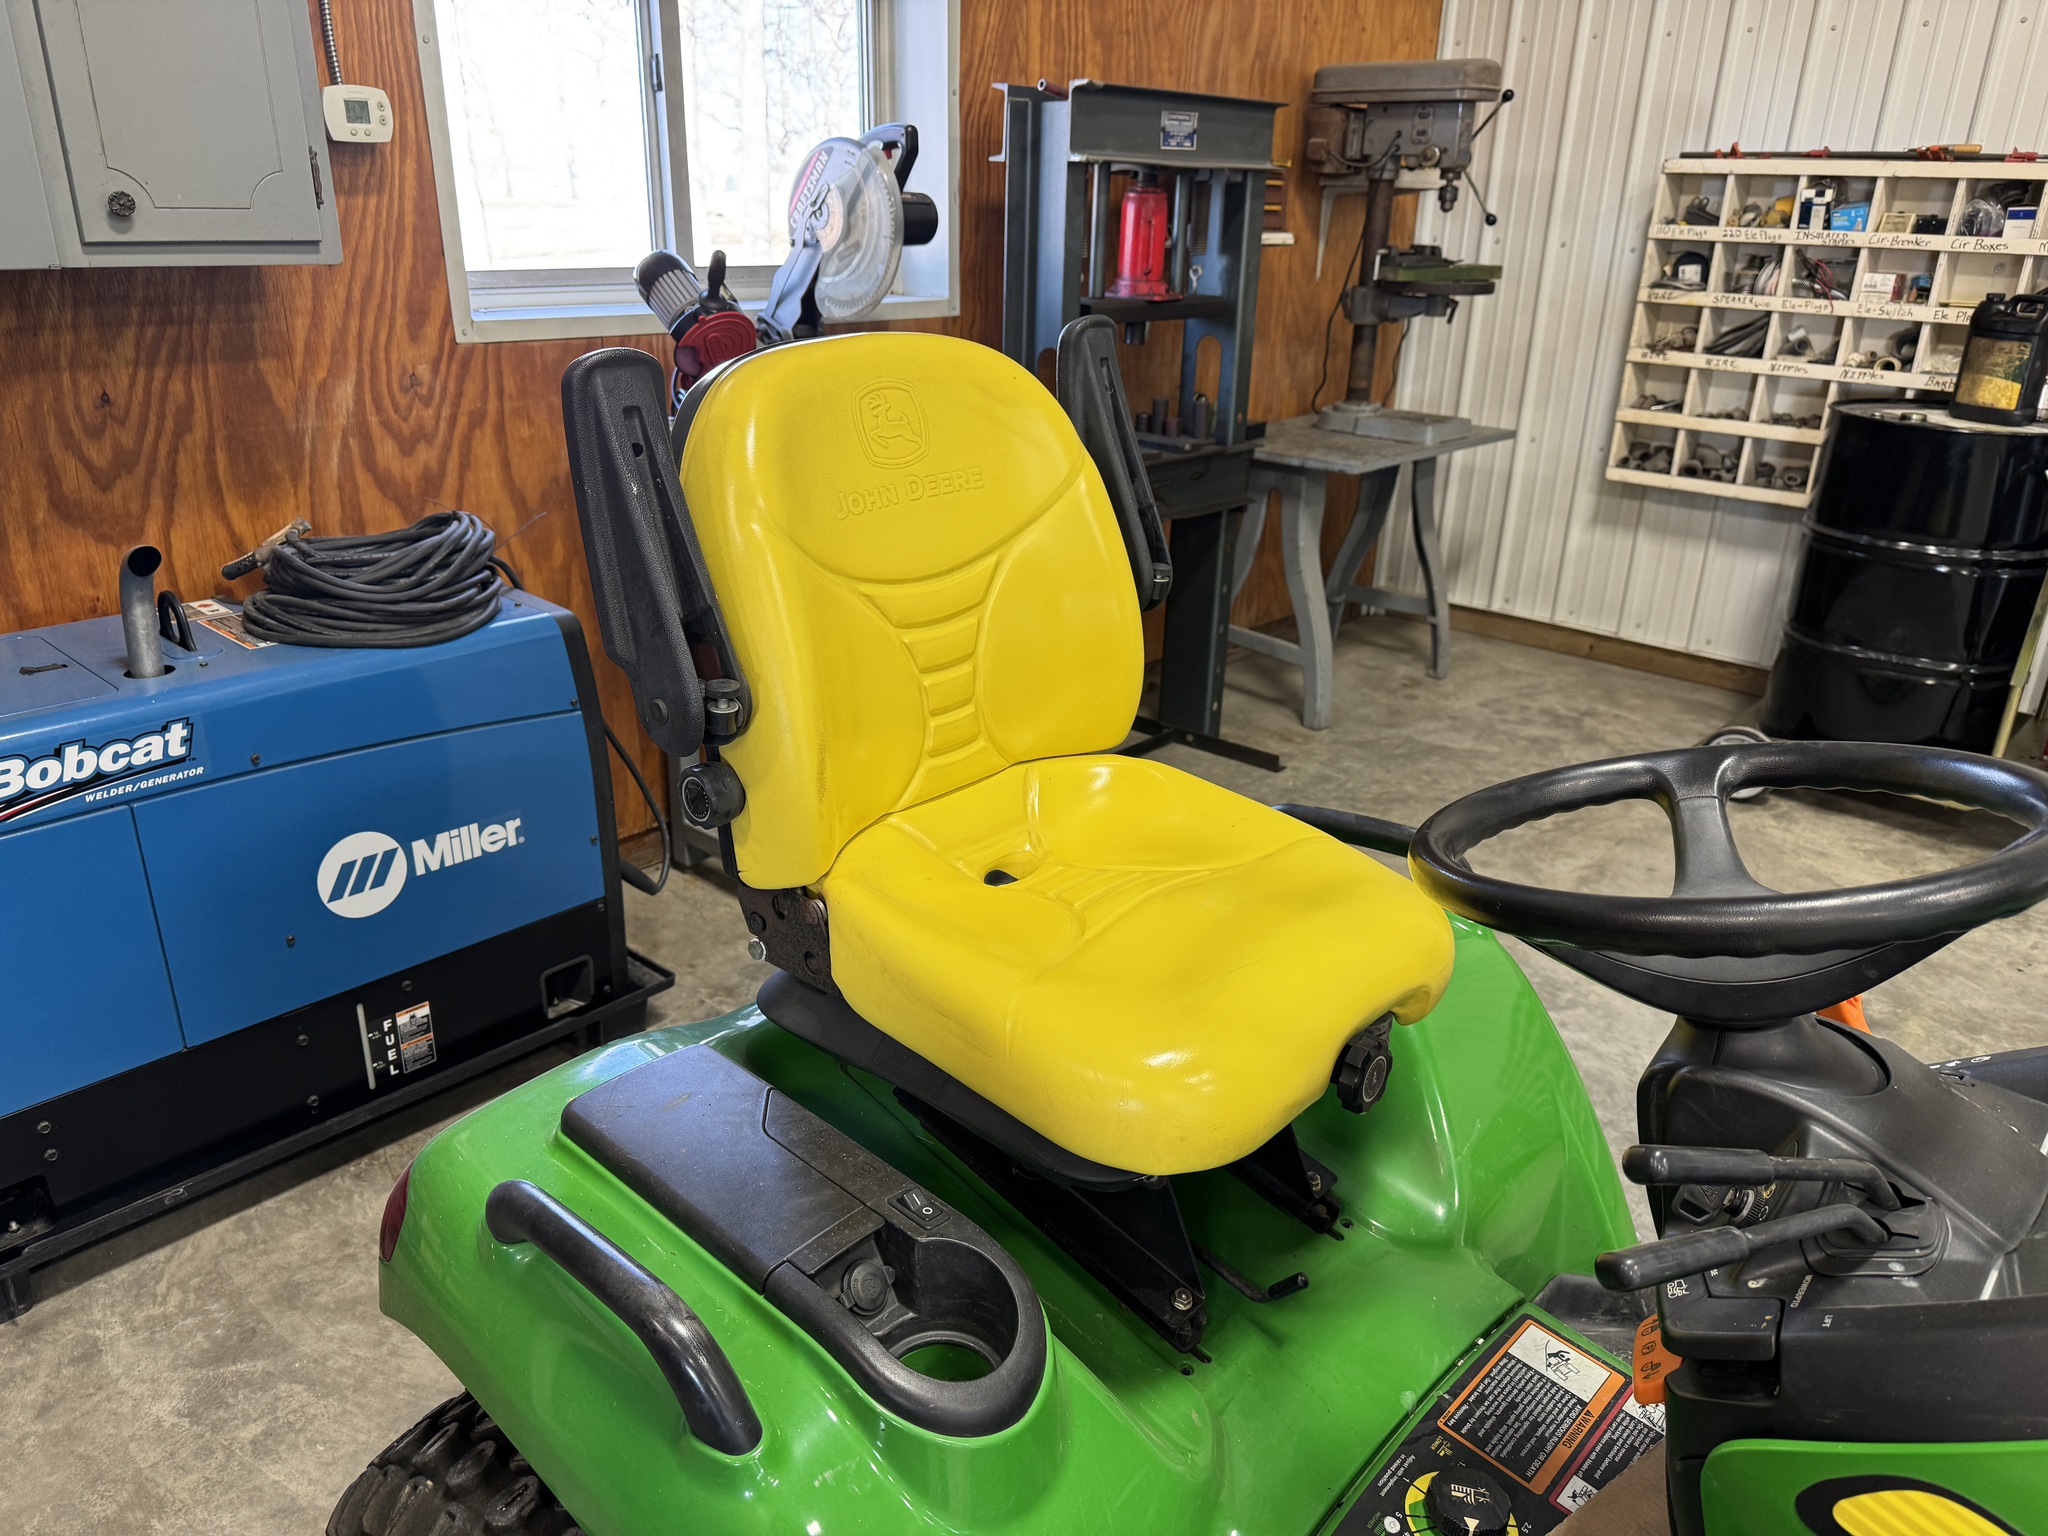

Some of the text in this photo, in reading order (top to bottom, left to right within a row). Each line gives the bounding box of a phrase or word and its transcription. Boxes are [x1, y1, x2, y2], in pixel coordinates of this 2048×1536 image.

[789, 150, 829, 229] CRAFTSMAN
[1722, 228, 1740, 238] 220
[1950, 238, 2009, 251] Cir Boxes
[836, 467, 985, 520] JOHN DEERE
[84, 766, 205, 803] WELDER/GENERATOR
[411, 817, 521, 877] Miller
[382, 1018, 400, 1076] FUEL
[1821, 1314, 1834, 1328] LIFT
[1430, 1435, 1444, 1451] LOWER
[1524, 1404, 1582, 1477] AVOID SERIOUS INJURY OR DEATH
[1561, 1414, 1591, 1449] WARNING
[1375, 1468, 1393, 1486] position
[1377, 1454, 1416, 1496] Adjust with implement
[1389, 1458, 1402, 1471] raised
[1395, 1511, 1403, 1519] 5
[1521, 1521, 1532, 1534] 2.5
